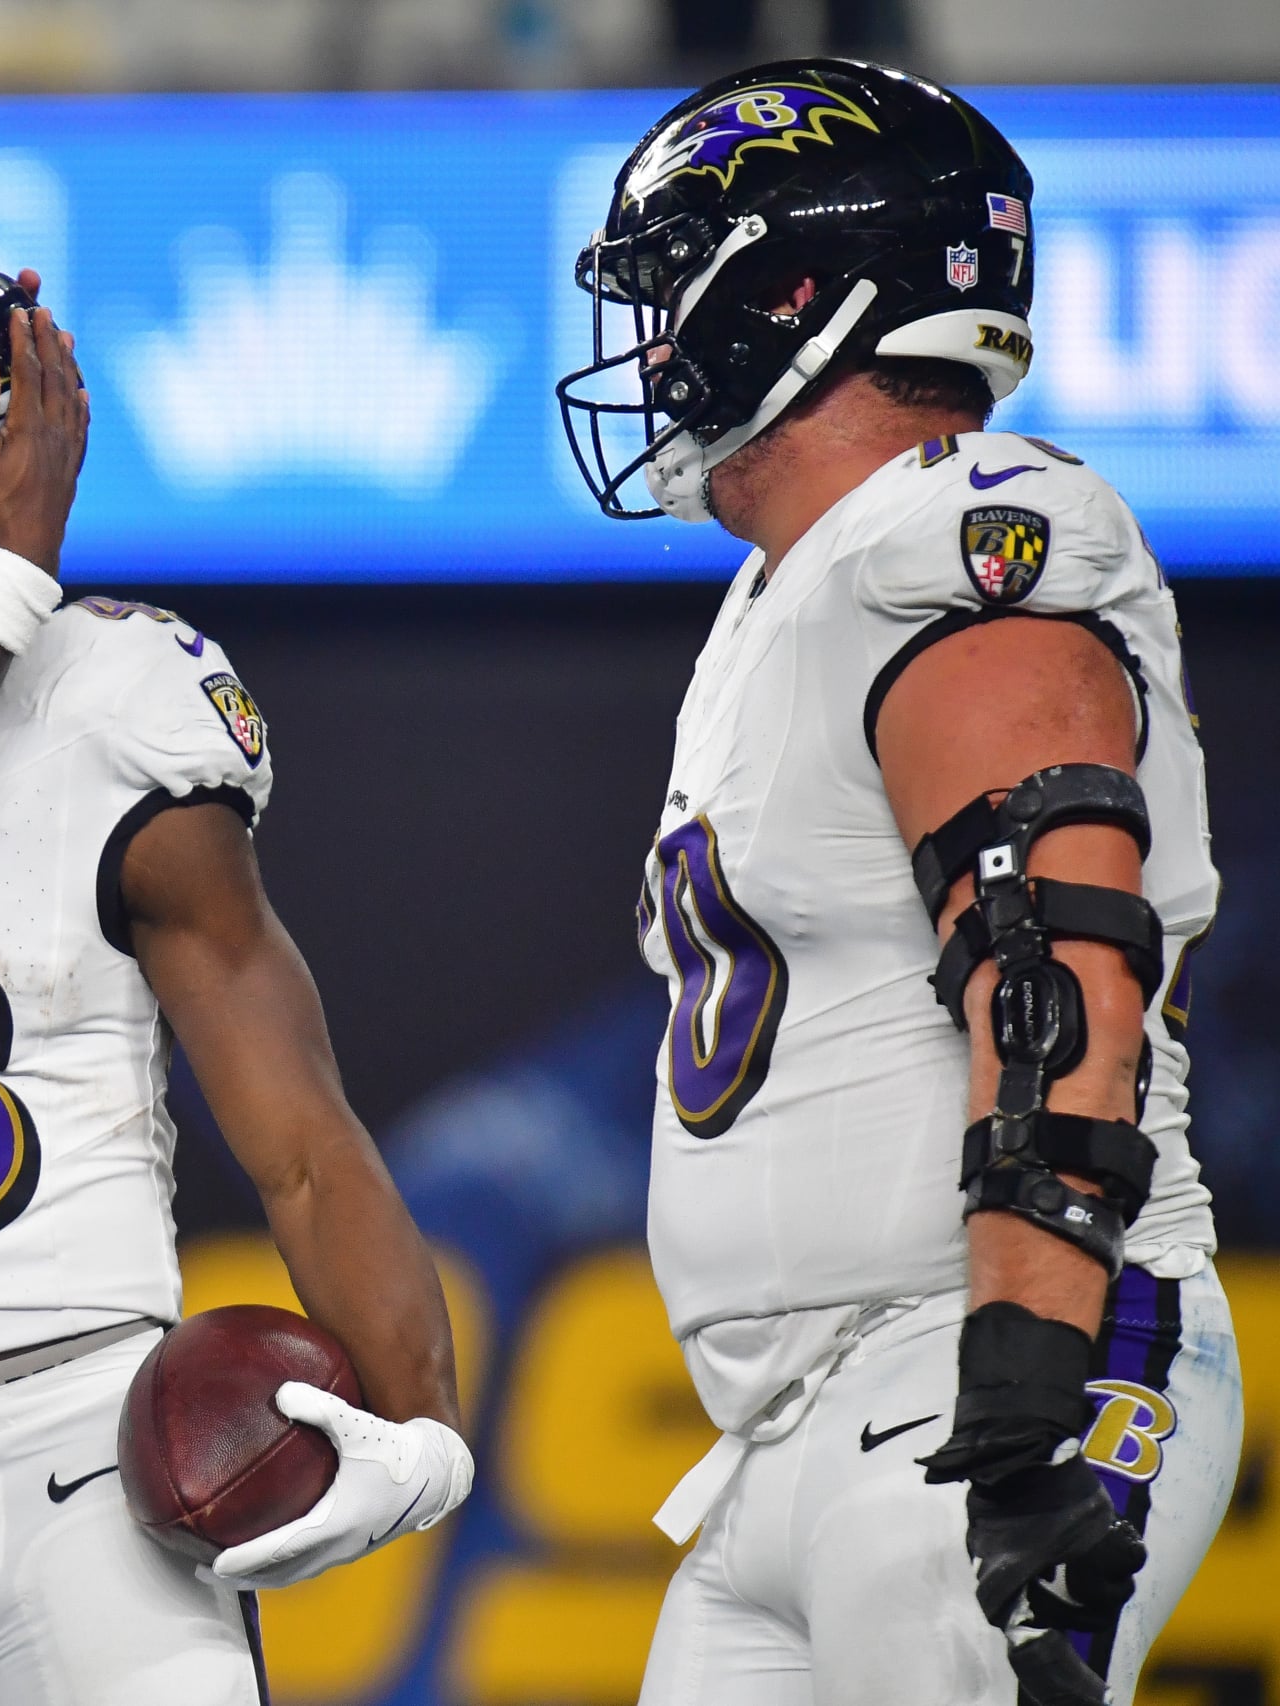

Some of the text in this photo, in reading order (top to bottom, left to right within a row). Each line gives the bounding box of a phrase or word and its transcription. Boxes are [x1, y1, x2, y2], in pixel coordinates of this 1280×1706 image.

[952, 263, 975, 283] NFL
[970, 509, 1043, 529] RAVENS
[1079, 1379, 1177, 1484] B
